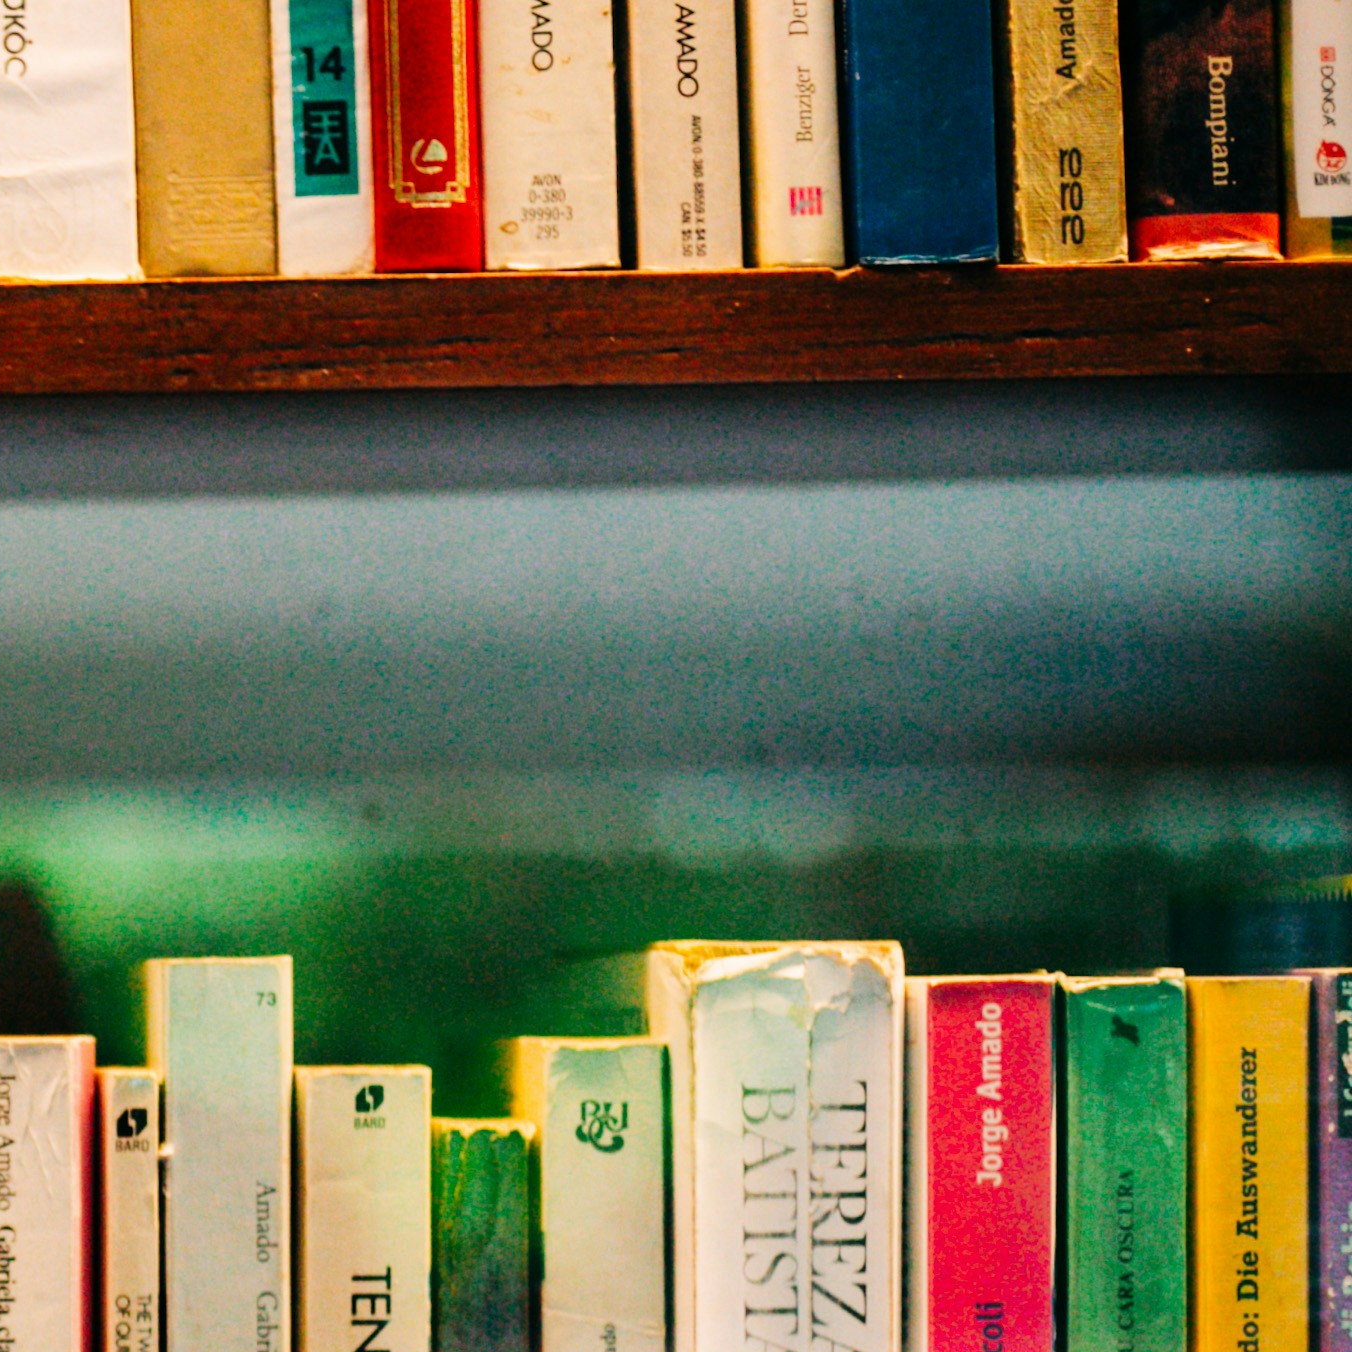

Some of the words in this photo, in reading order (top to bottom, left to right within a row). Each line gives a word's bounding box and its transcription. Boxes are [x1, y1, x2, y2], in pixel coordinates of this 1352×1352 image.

[300, 46, 347, 82] 14
[675, 3, 700, 98] AMADO
[795, 65, 817, 143] Benziger
[1207, 54, 1237, 187] Bompiani
[535, 223, 562, 241] 295
[256, 992, 278, 1007] 73
[976, 1002, 1003, 1099] Amado
[114, 1138, 151, 1153] BARD
[353, 1117, 387, 1130] BARD
[976, 1102, 1010, 1188] Jorge
[1237, 1045, 1260, 1240] Auswanderer
[255, 1180, 277, 1264] Amado
[1116, 1168, 1135, 1269] OSCURA
[1237, 1246, 1260, 1303] Die
[116, 1294, 133, 1319] OF
[137, 1294, 153, 1325] THE
[1117, 1275, 1135, 1333] CARA
